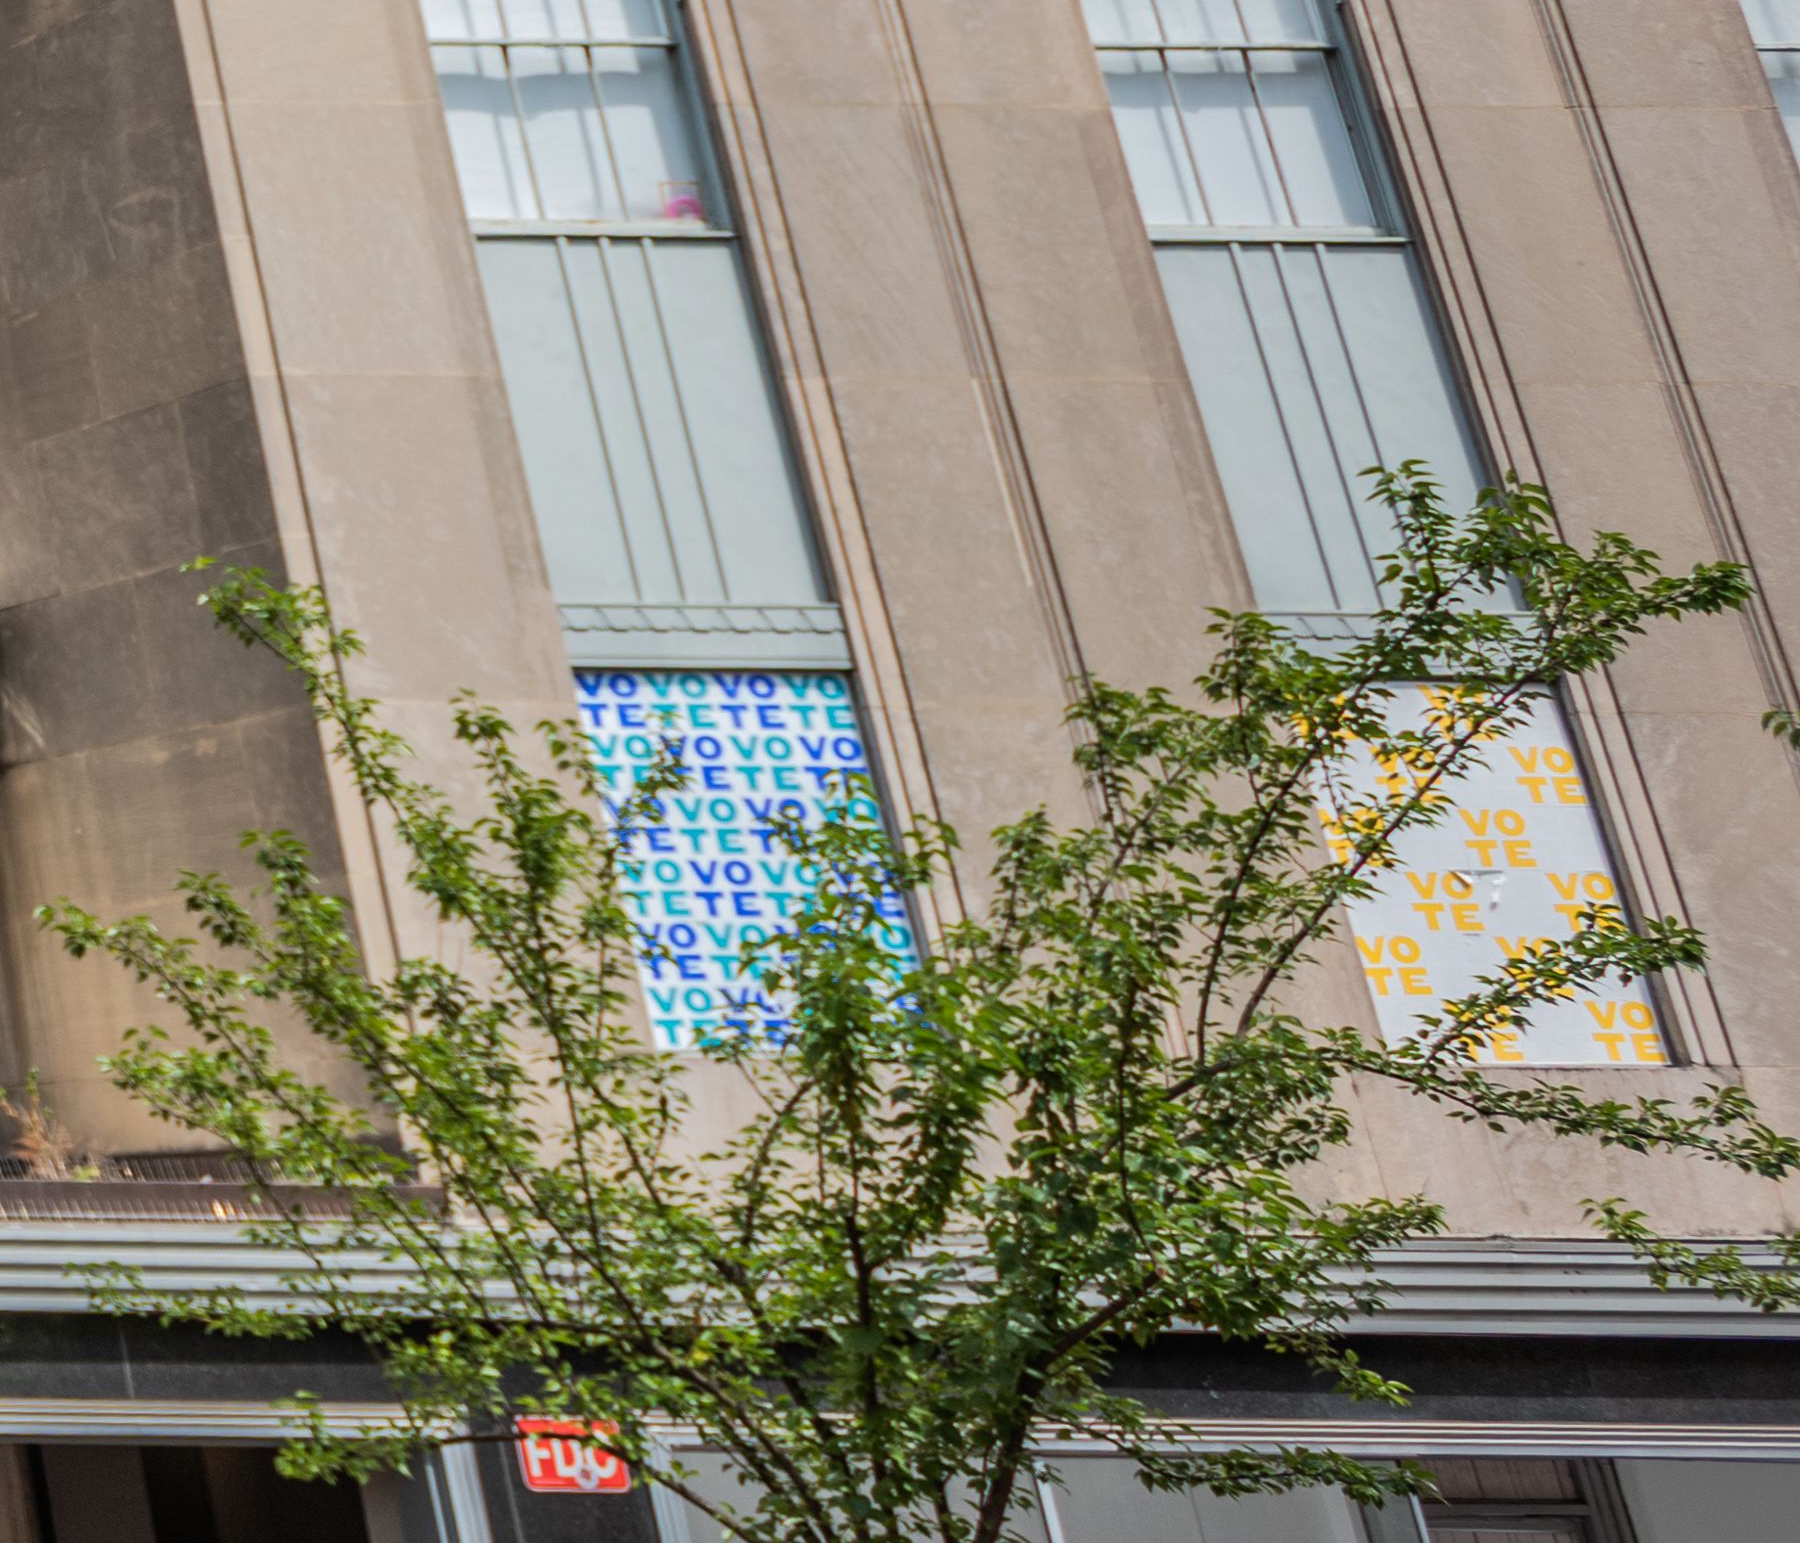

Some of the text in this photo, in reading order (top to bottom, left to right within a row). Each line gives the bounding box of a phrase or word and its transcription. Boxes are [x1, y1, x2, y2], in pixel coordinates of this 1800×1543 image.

[1508, 746, 1574, 773] VO
[1516, 777, 1587, 804] TE
[1458, 809, 1525, 836] VO
[1464, 839, 1537, 867] TE
[1405, 872, 1473, 899] VO
[1546, 872, 1614, 900] VO
[1411, 903, 1485, 931] TE
[1354, 936, 1421, 964] VO
[1364, 967, 1433, 995] TE
[1583, 1001, 1655, 1030] VO
[1593, 1033, 1667, 1062] TE
